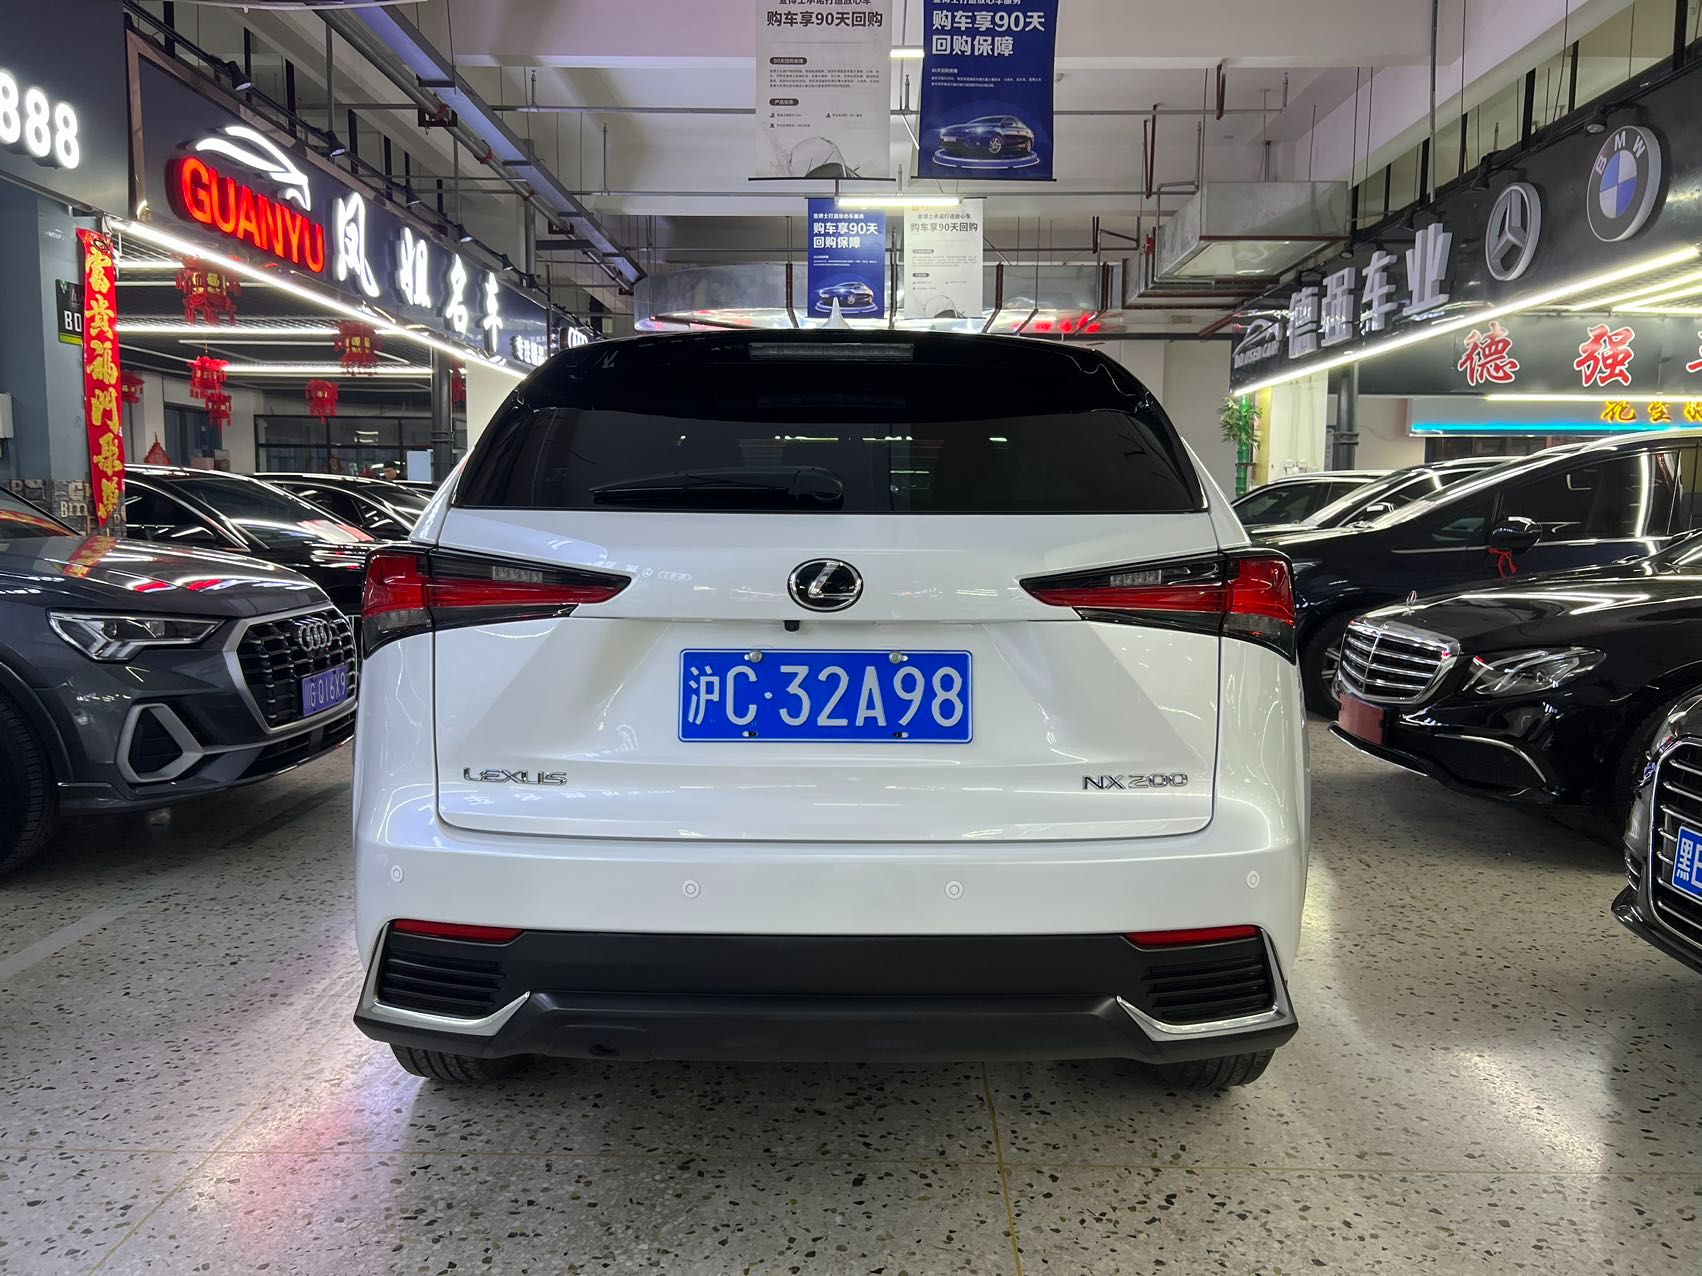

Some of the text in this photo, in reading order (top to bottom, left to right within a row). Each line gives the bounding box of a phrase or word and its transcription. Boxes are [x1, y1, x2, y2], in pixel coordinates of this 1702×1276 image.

[766, 11, 884, 28] 购车享90天回购
[931, 10, 1046, 32] 购车享90天
[931, 35, 1014, 57] 回购保障
[1595, 130, 1647, 175] BMW
[181, 156, 326, 273] GUANYU
[813, 222, 879, 235] 购车享90天
[911, 222, 978, 232] 购车享90天回购
[813, 236, 861, 249] 回购保障
[1288, 222, 1453, 360] 德强车业
[463, 767, 568, 787] LEXUS
